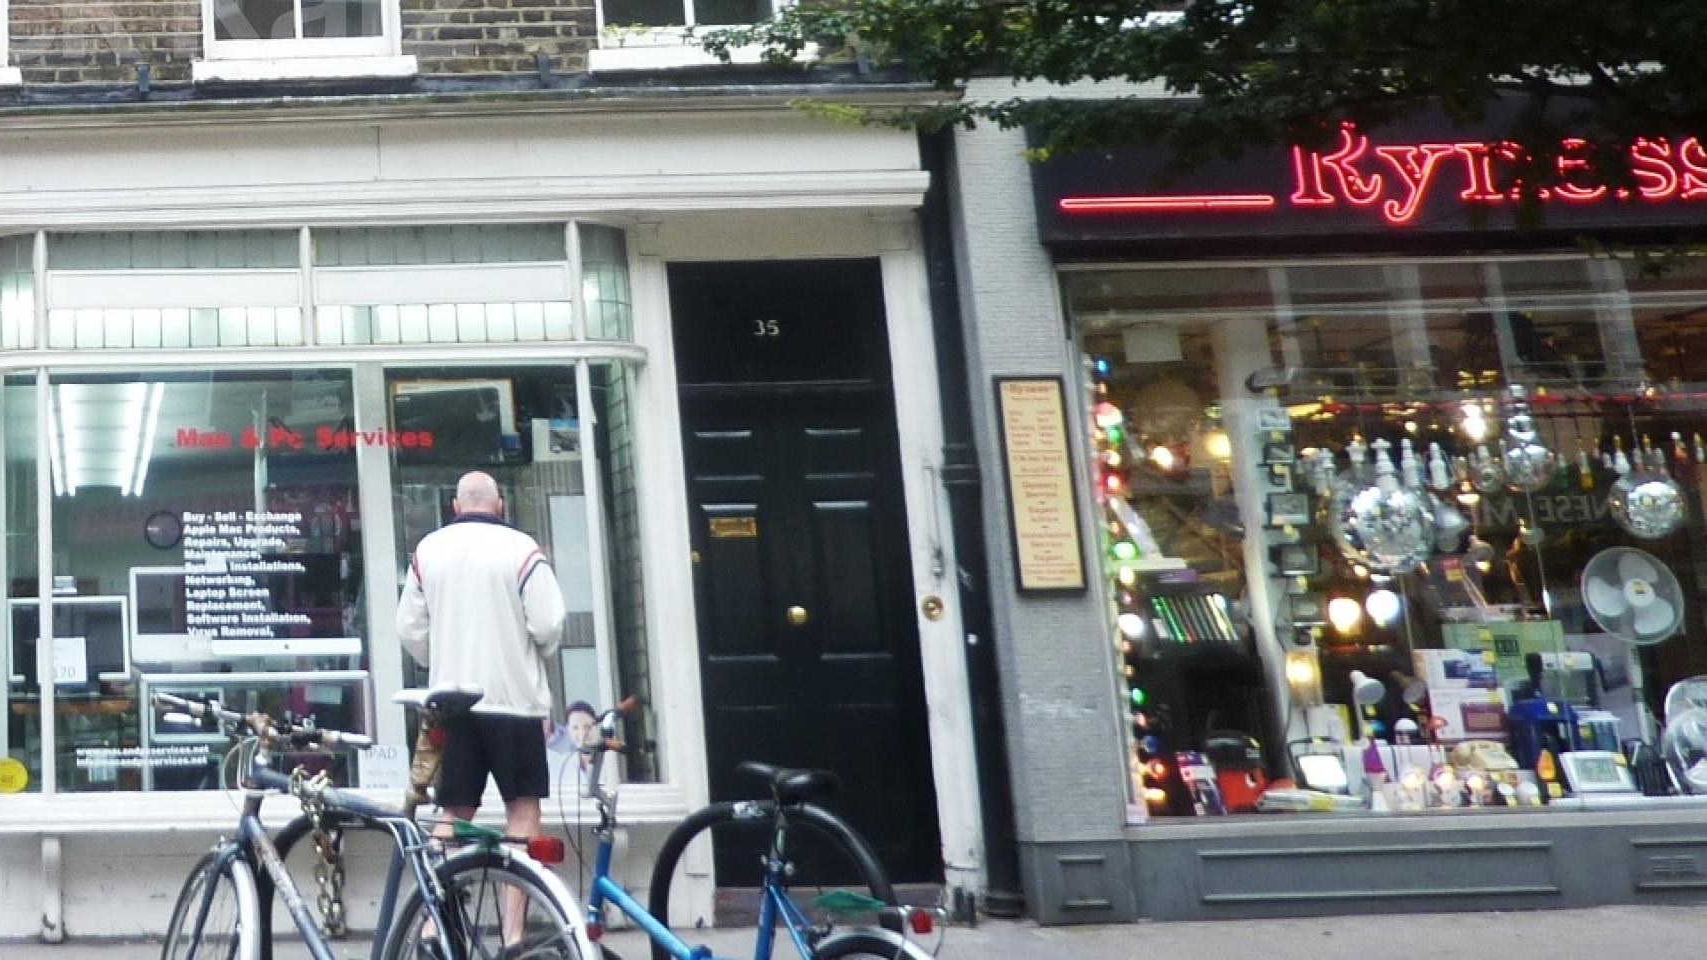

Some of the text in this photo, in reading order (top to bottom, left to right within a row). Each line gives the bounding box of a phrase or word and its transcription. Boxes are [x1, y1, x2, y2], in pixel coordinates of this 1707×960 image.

[754, 319, 780, 336] 35
[175, 427, 231, 449] Mac
[316, 426, 434, 449] Services
[183, 511, 205, 523] Buy
[214, 511, 235, 522] Sell
[245, 511, 301, 523] Exchange
[183, 524, 216, 536] Apple
[218, 524, 242, 534] Mac
[185, 587, 269, 599] Laptop Screen
[186, 612, 239, 624] Software
